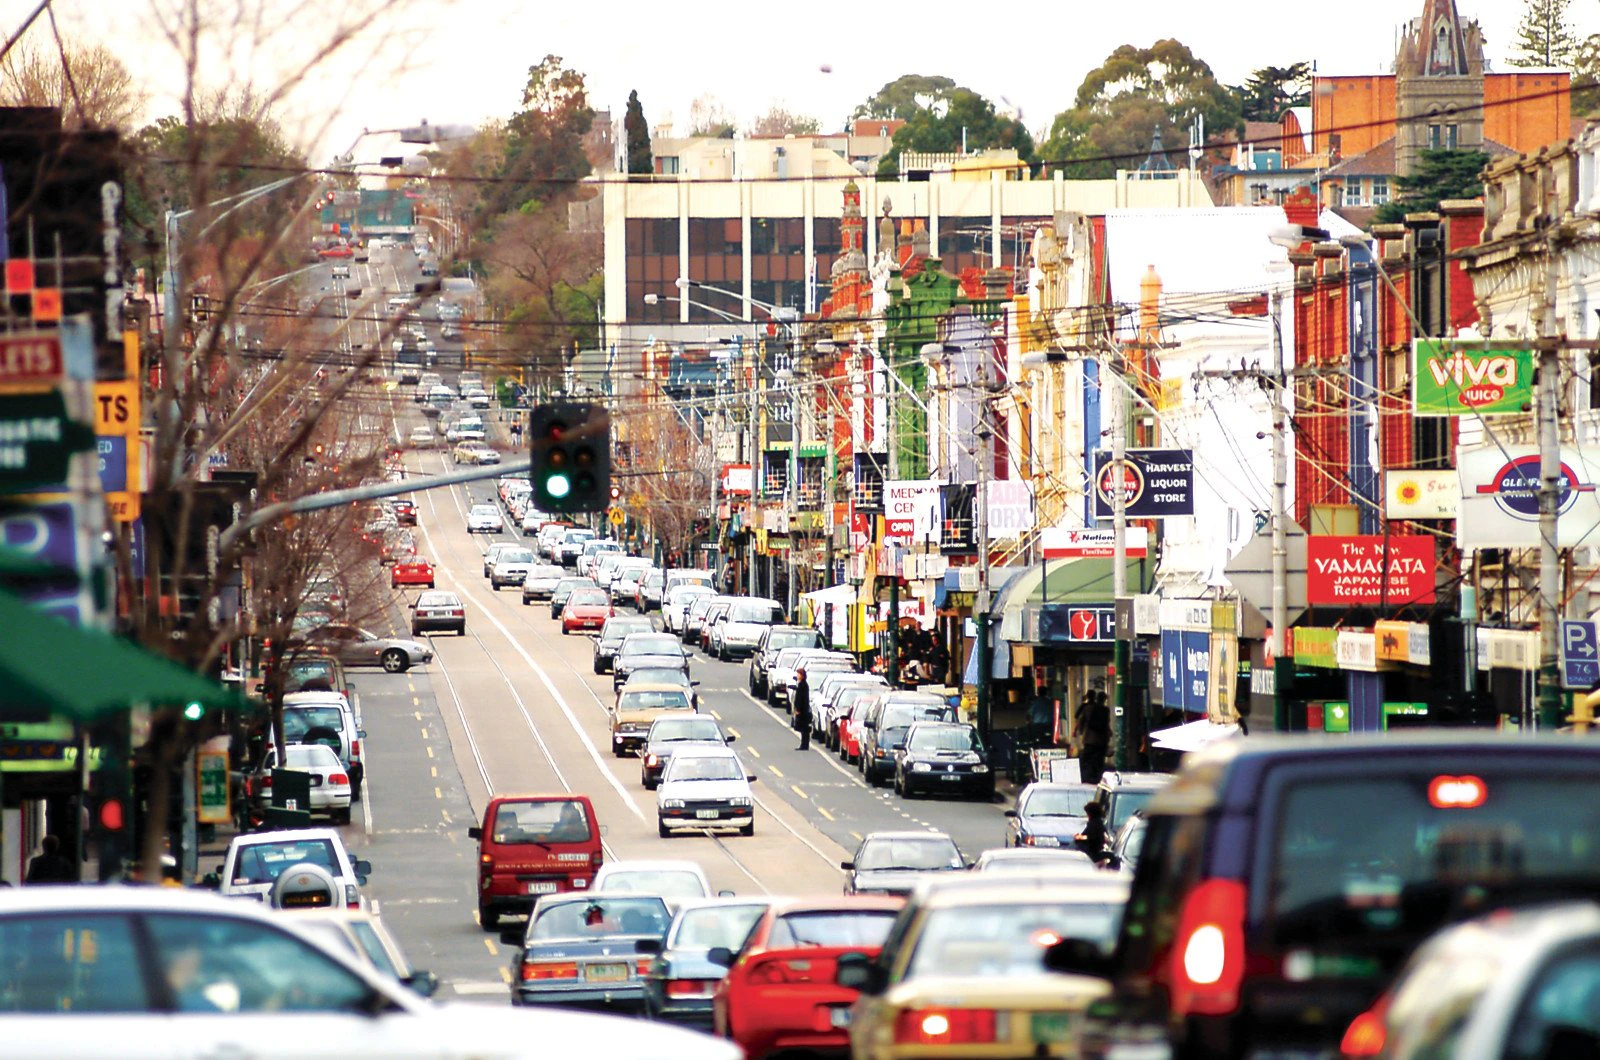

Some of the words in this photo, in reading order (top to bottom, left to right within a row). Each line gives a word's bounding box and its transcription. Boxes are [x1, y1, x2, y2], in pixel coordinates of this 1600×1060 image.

[1145, 463, 1192, 473] HARVEST
[1105, 481, 1137, 489] TOYS
[1150, 478, 1188, 489] LIQUOR
[1108, 489, 1134, 500] NW
[1153, 493, 1186, 503] STORE
[891, 522, 914, 533] OPEN
[1342, 543, 1365, 555] The
[1374, 544, 1400, 555] Nw
[1334, 576, 1408, 585] JAPANSE
[1334, 585, 1410, 596] Restauant
[1566, 624, 1587, 652] P
